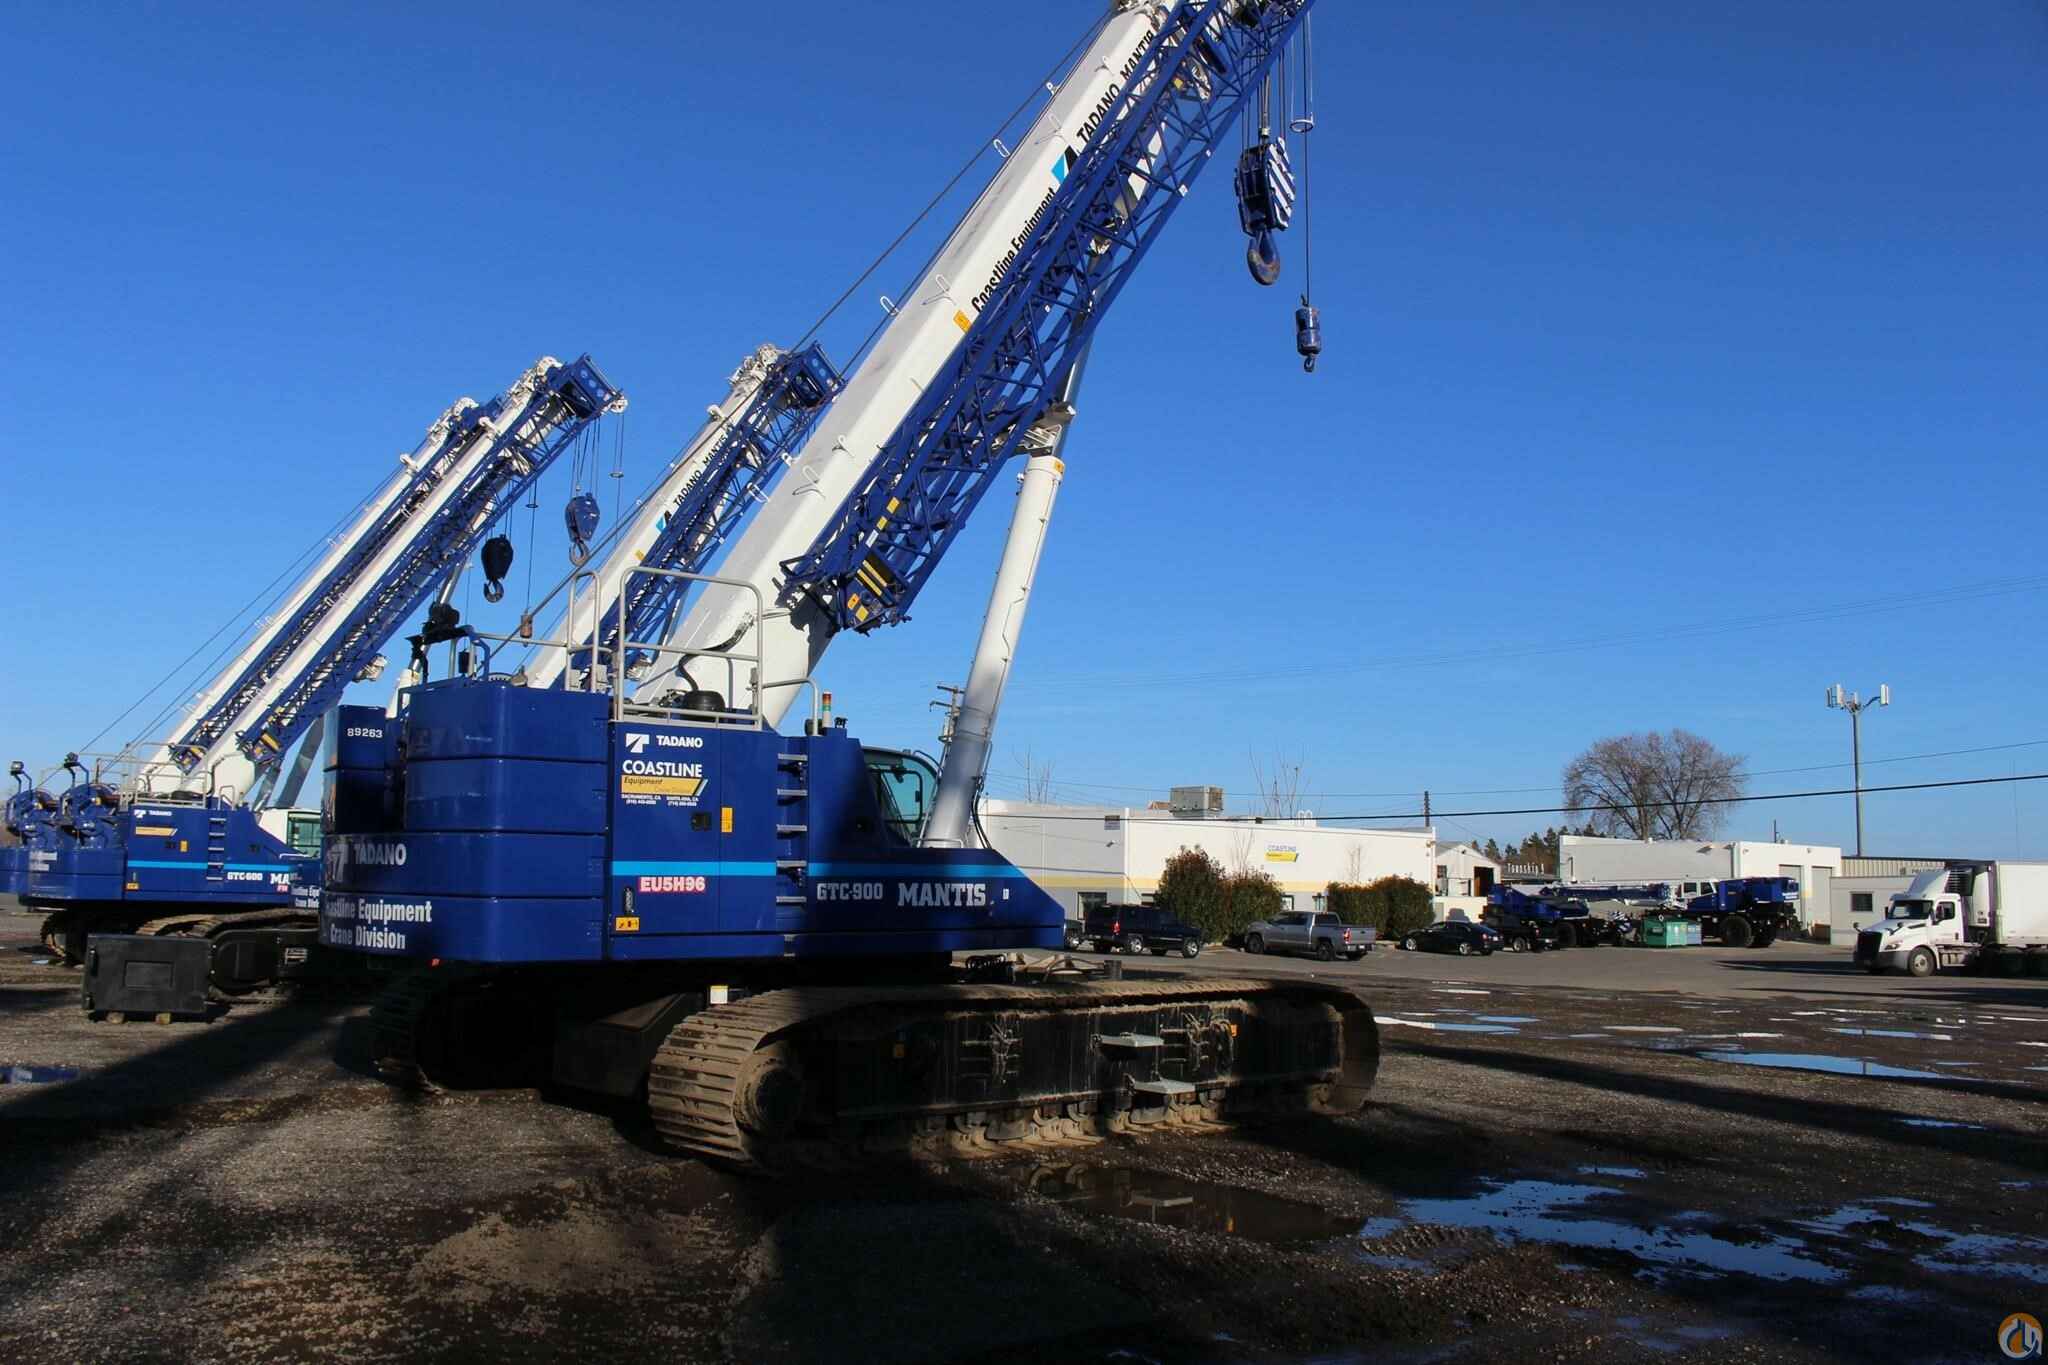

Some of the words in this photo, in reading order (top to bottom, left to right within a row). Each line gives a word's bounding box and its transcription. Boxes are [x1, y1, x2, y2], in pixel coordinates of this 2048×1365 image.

[1076, 83, 1120, 143] TADANO
[673, 469, 701, 506] TADANO
[346, 727, 383, 738] 89263
[656, 735, 704, 748] TADANO
[622, 760, 703, 777] COASTLINE
[624, 776, 663, 785] Equipment
[353, 844, 407, 866] TADANO
[640, 876, 706, 892] EU5H96
[817, 883, 883, 900] GTC-900
[898, 883, 986, 906] MANTIS
[358, 899, 432, 925] Equipment
[355, 926, 406, 949] Division
